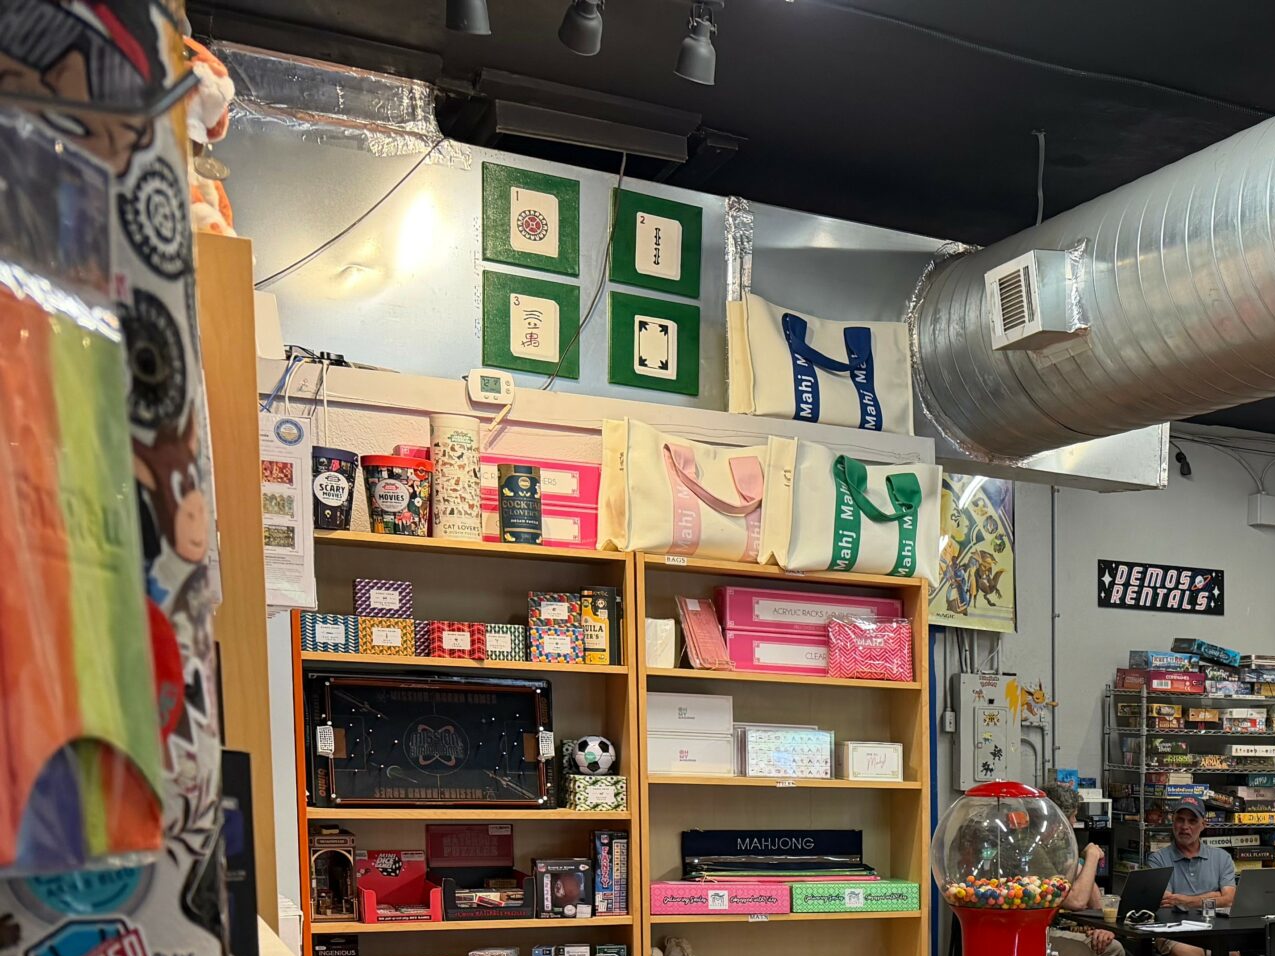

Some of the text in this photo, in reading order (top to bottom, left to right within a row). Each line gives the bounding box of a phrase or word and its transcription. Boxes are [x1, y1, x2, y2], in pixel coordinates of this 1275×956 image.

[514, 190, 519, 202] 1
[639, 215, 646, 225] 2
[513, 295, 521, 306] 3
[797, 374, 813, 419] Mahj
[864, 389, 878, 429] Mahj
[319, 483, 345, 493] SCARY
[457, 524, 480, 532] LOVERS
[836, 522, 856, 572] Mahj
[897, 539, 914, 578] Mahj
[1114, 565, 1190, 589] DEMOS
[1110, 585, 1208, 611] RENTALS
[773, 607, 824, 618] ACRYLIC RACKS
[805, 652, 827, 661] CLEAR
[737, 837, 815, 850] MAHJONG
